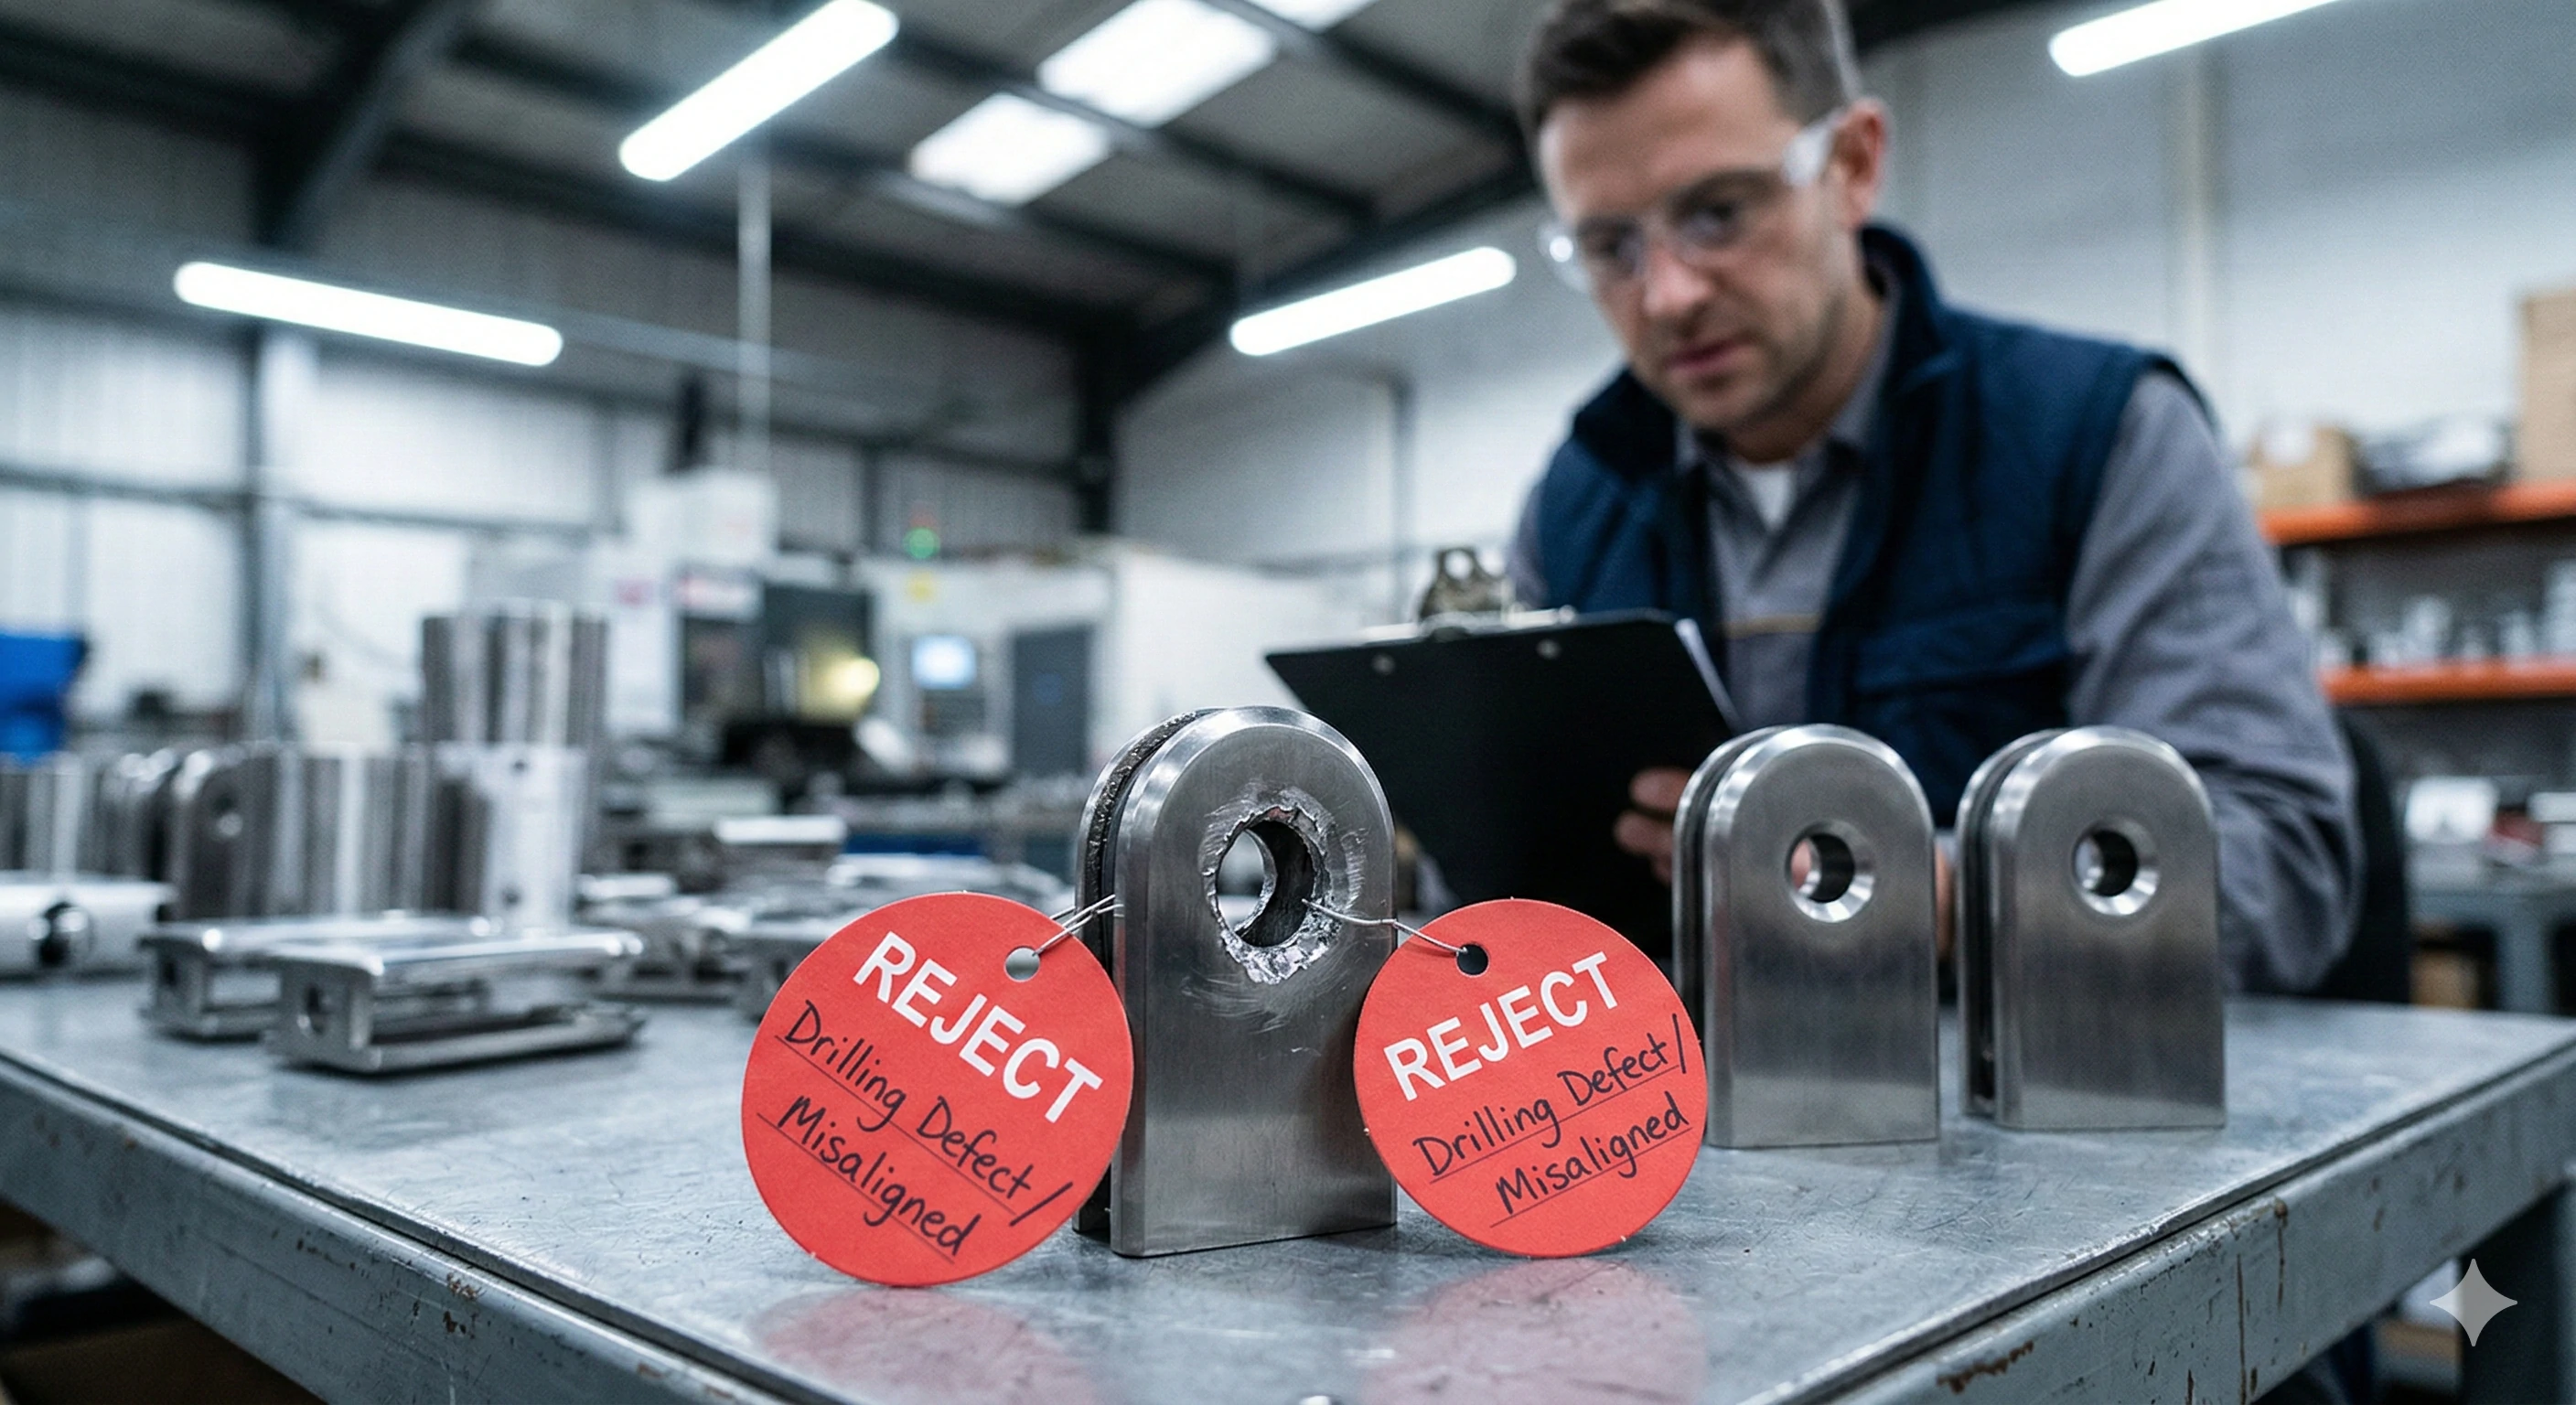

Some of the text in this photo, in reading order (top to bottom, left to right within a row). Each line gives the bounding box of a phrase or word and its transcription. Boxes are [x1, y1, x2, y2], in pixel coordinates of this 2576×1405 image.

[785, 999, 907, 1132] Drilling
[853, 931, 1103, 1123] REJECT
[1383, 951, 1617, 1101] REJECT
[778, 1095, 982, 1257] Misaligned
[1412, 1098, 1562, 1176] Drilling
[1495, 1090, 1690, 1215] Misaligned
